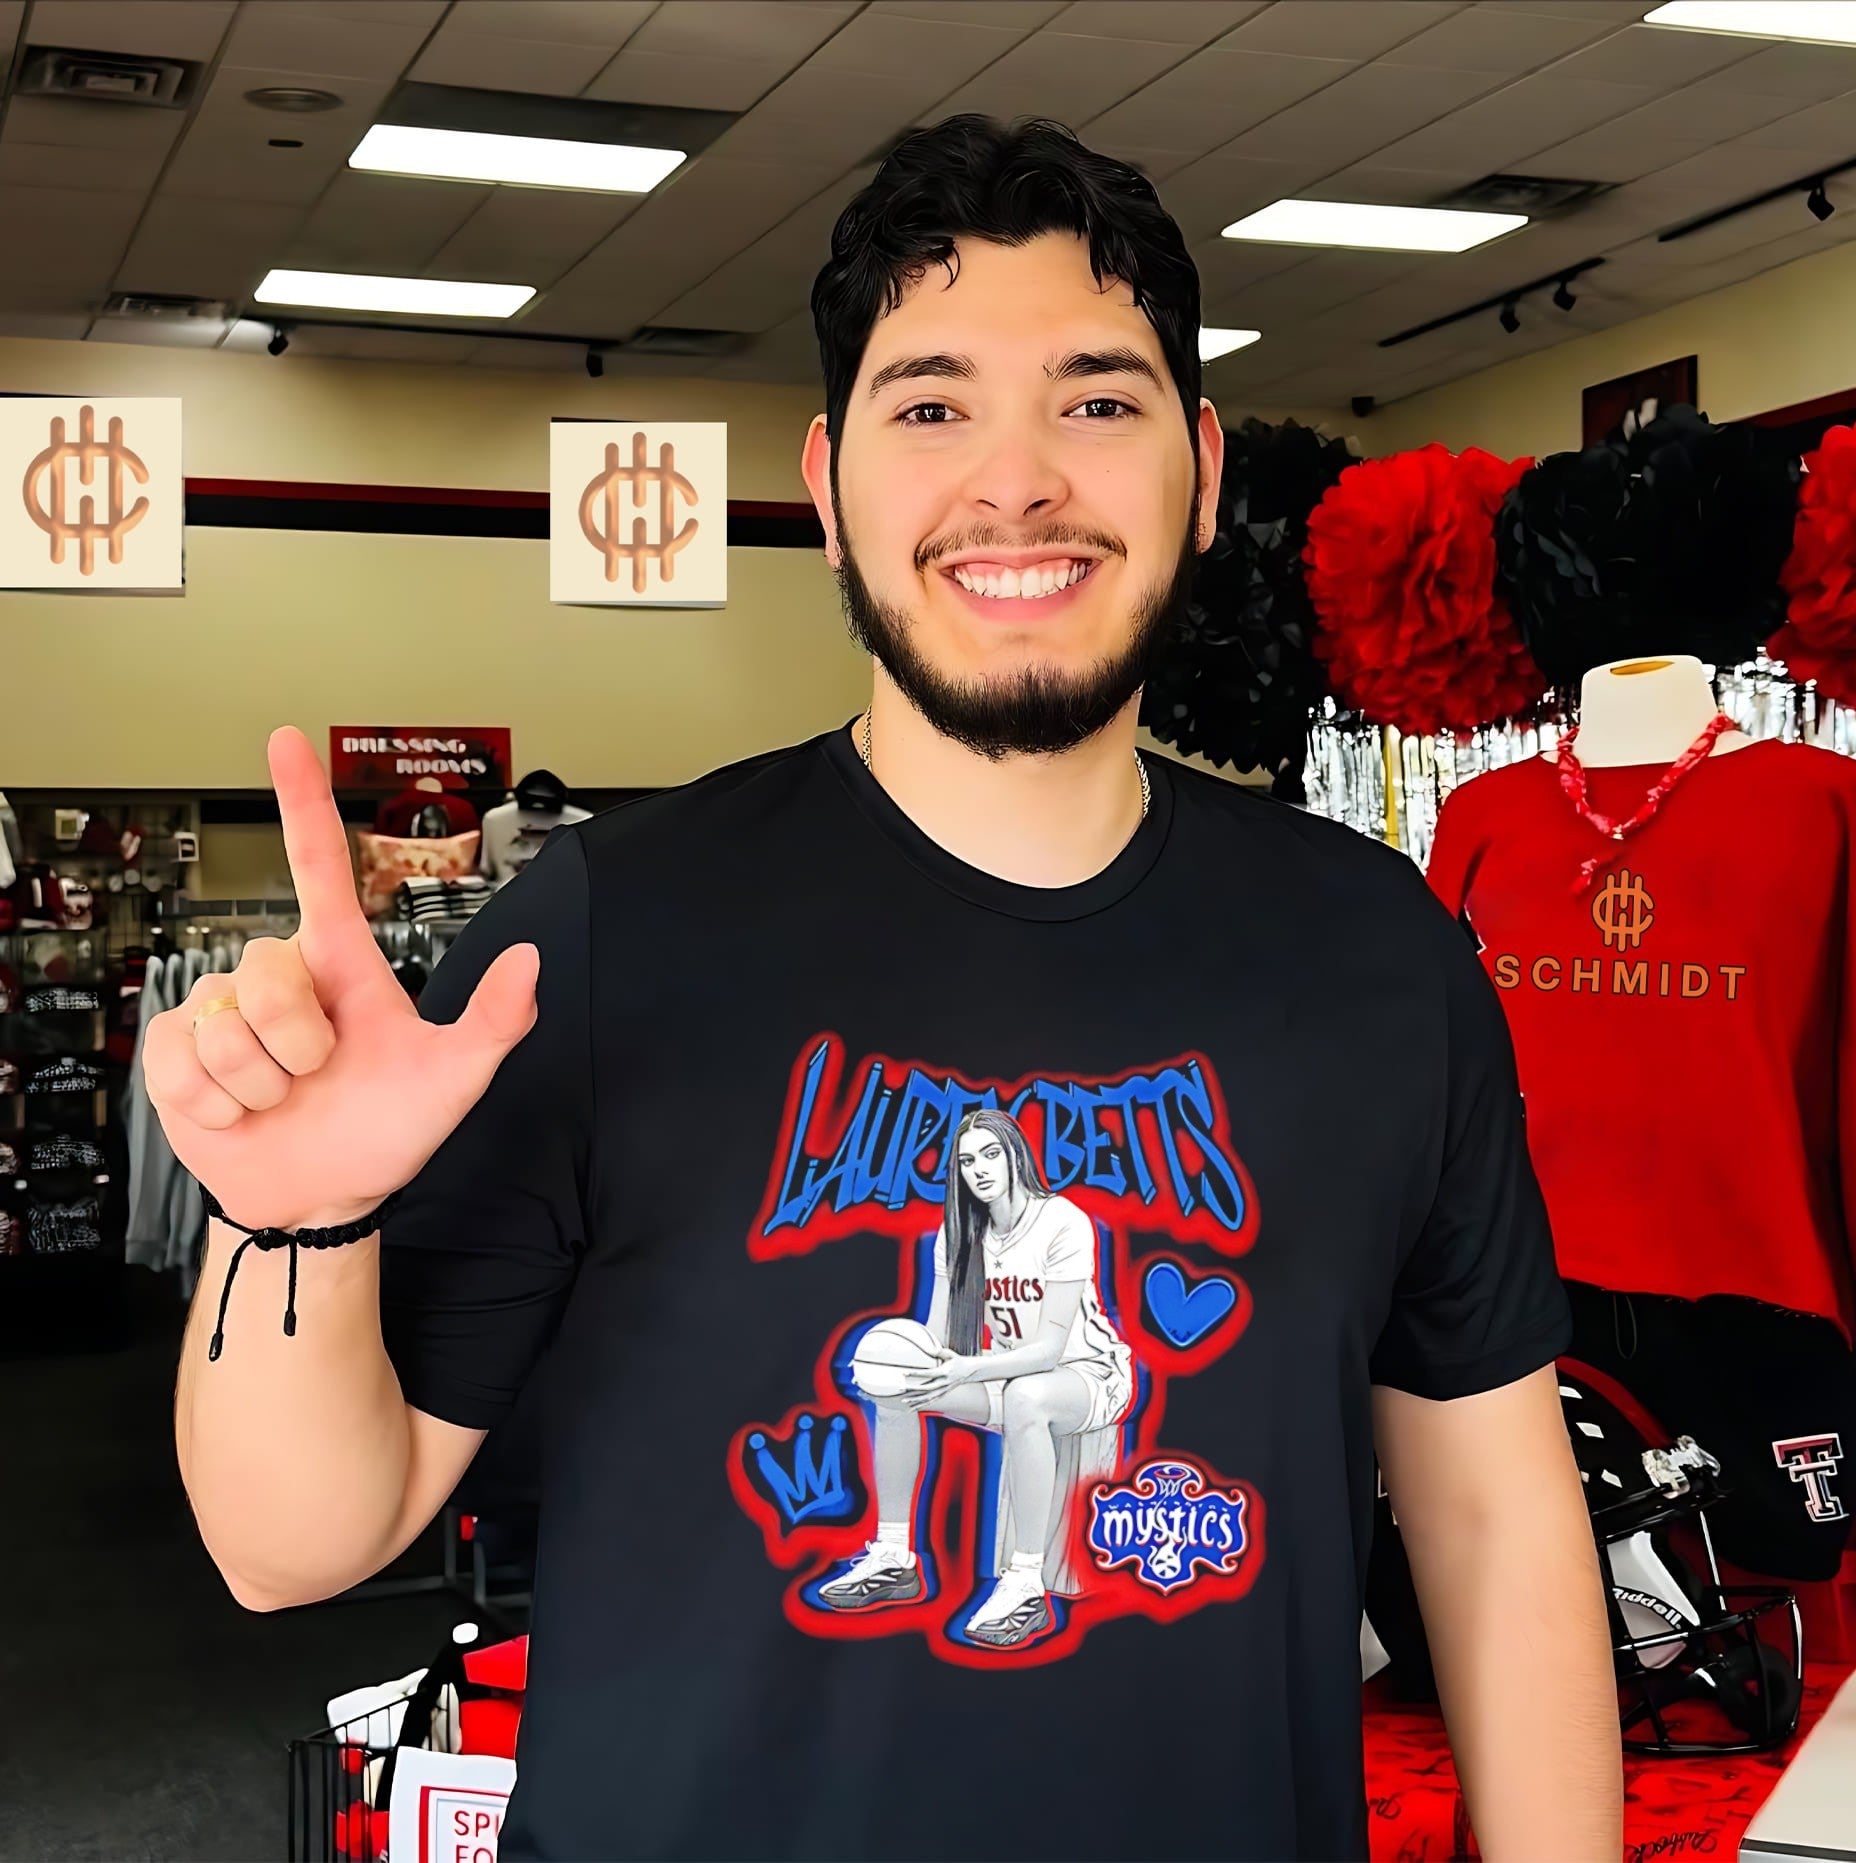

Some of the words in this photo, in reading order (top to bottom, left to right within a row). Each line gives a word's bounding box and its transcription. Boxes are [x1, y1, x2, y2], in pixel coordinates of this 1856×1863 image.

[396, 758, 487, 774] ROOMS
[1494, 954, 1747, 999] SCHMIDT
[764, 1040, 1032, 1236] LAURE
[1034, 1058, 1245, 1231] BETTS
[990, 1306, 1022, 1339] 51
[1102, 1505, 1233, 1550] mystics
